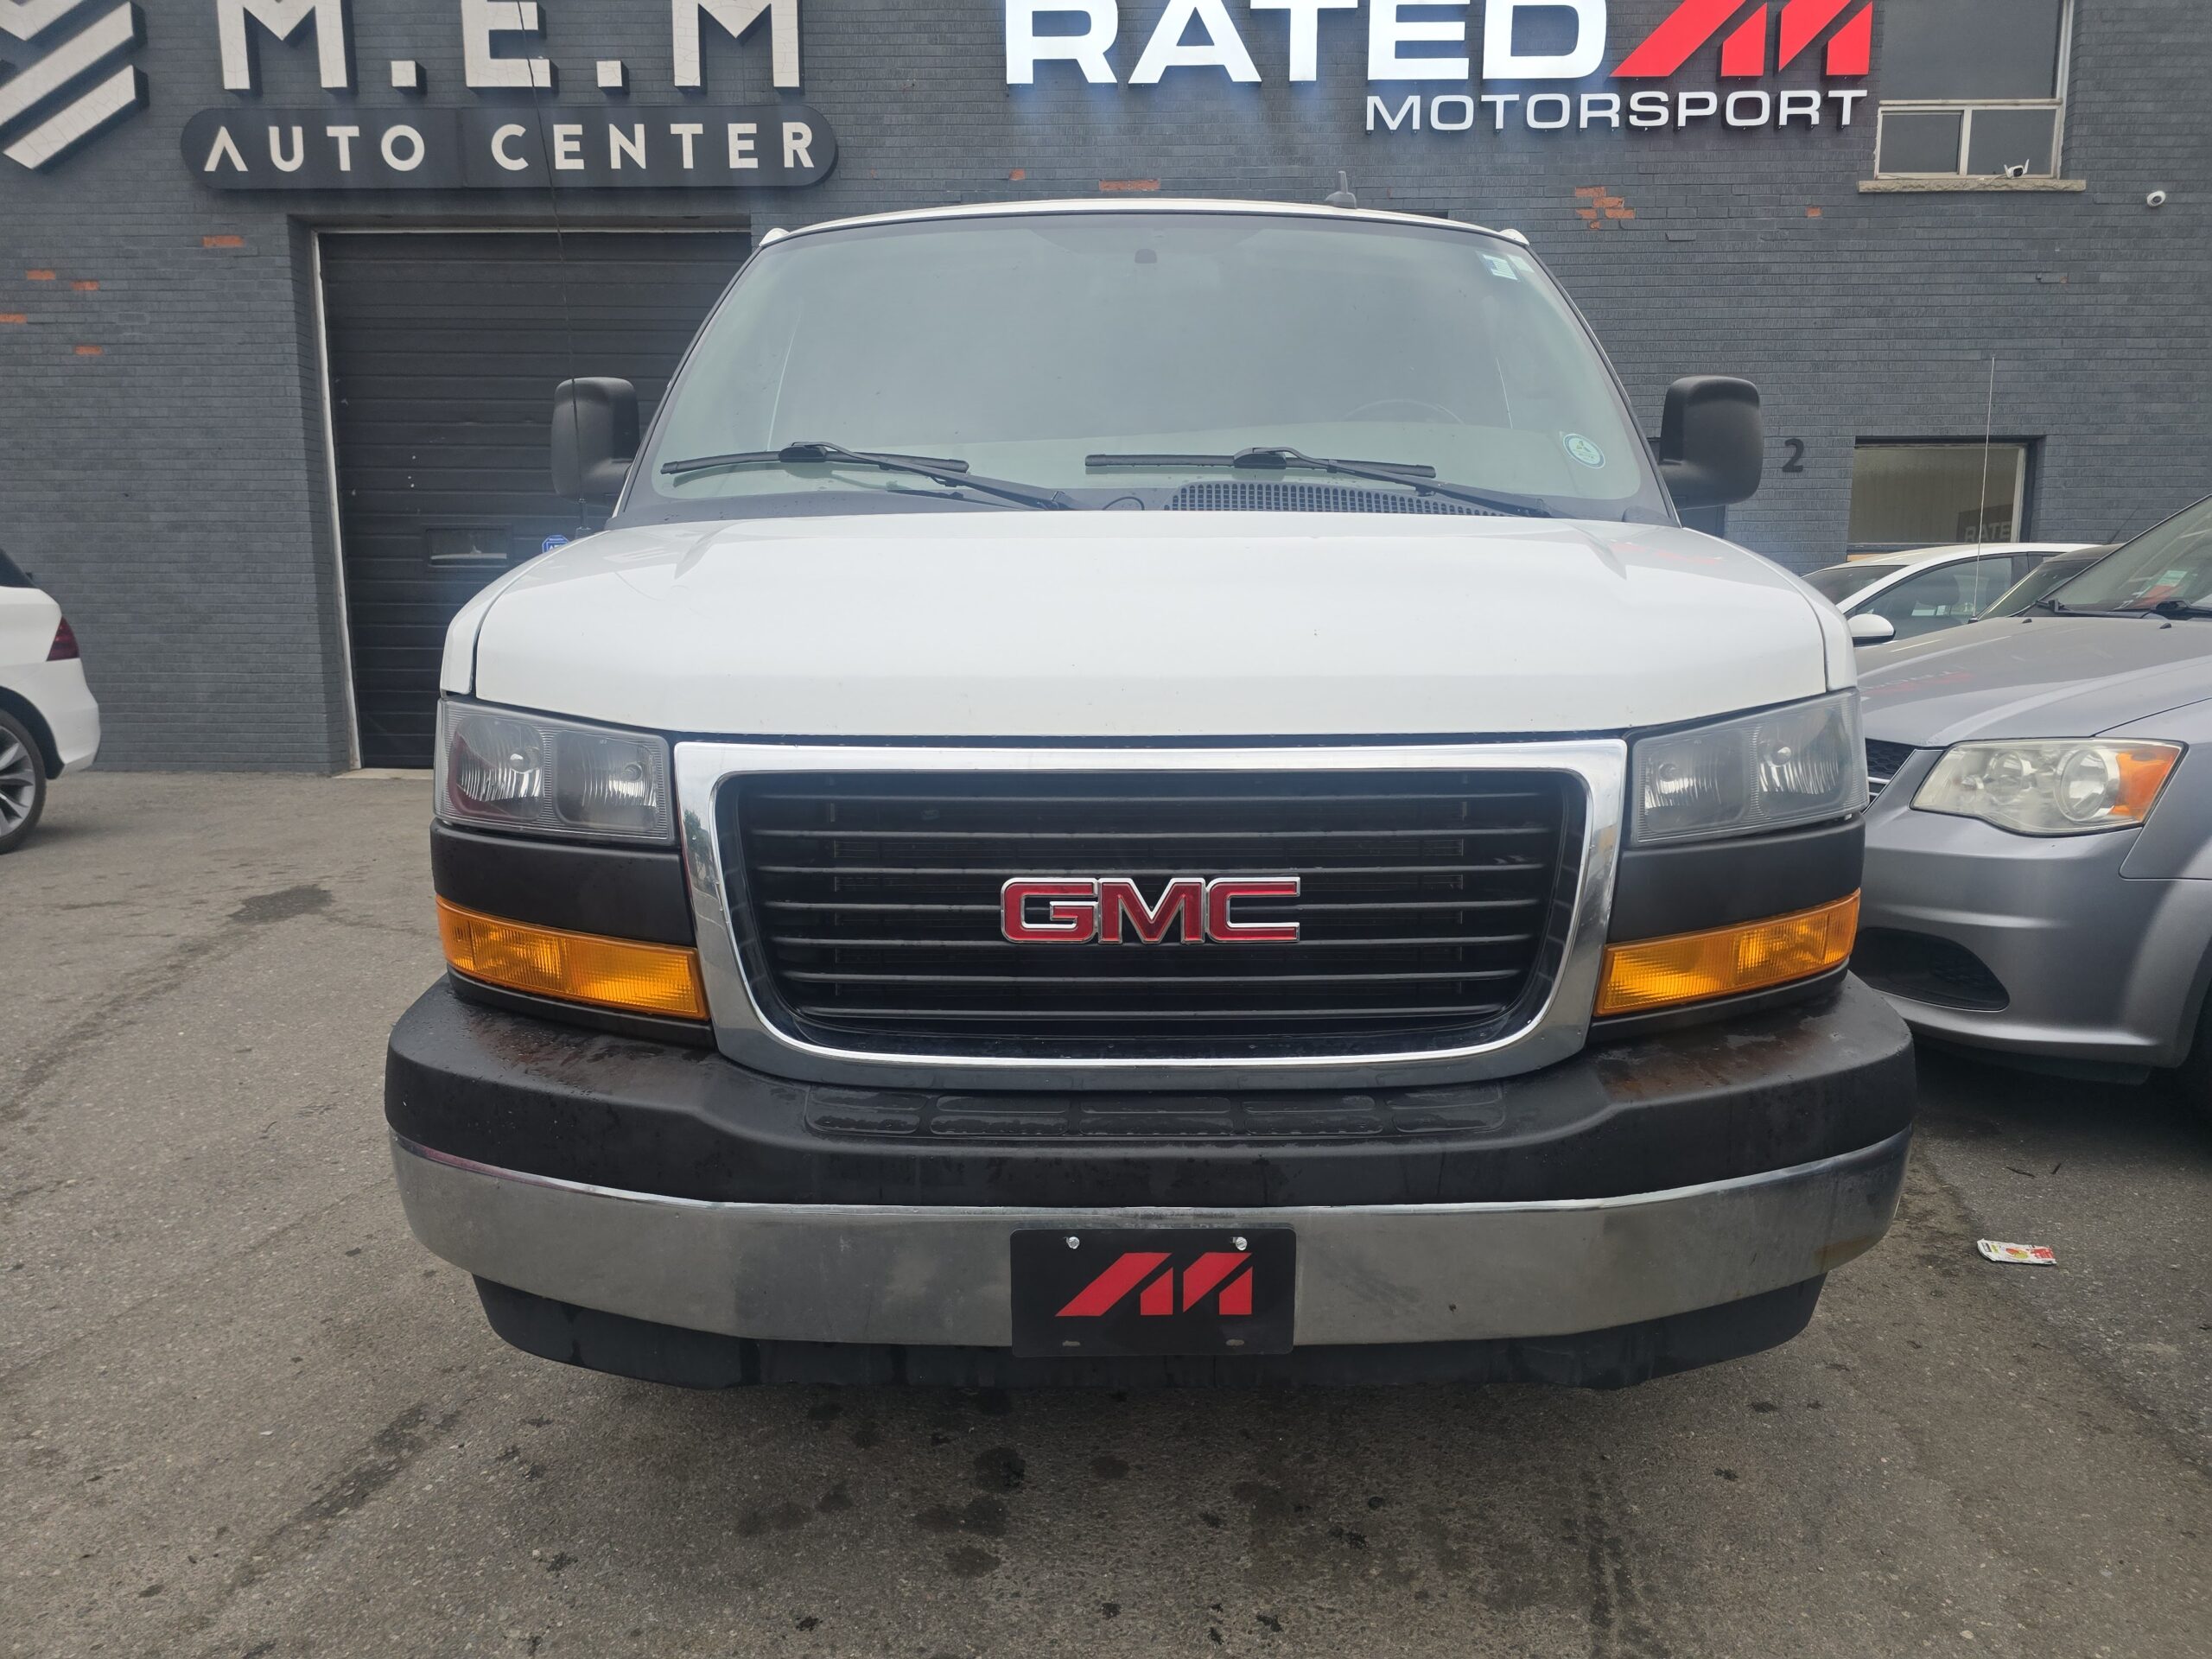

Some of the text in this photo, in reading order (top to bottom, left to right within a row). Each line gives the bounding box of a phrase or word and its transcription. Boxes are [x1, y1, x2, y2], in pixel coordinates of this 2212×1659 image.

[1005, 0, 1607, 85] RATED
[1365, 89, 1868, 131] MOTORSPORT
[204, 122, 815, 172] AUTO CENTER
[1782, 437, 1804, 473] 2
[1001, 877, 1300, 944] GMC
